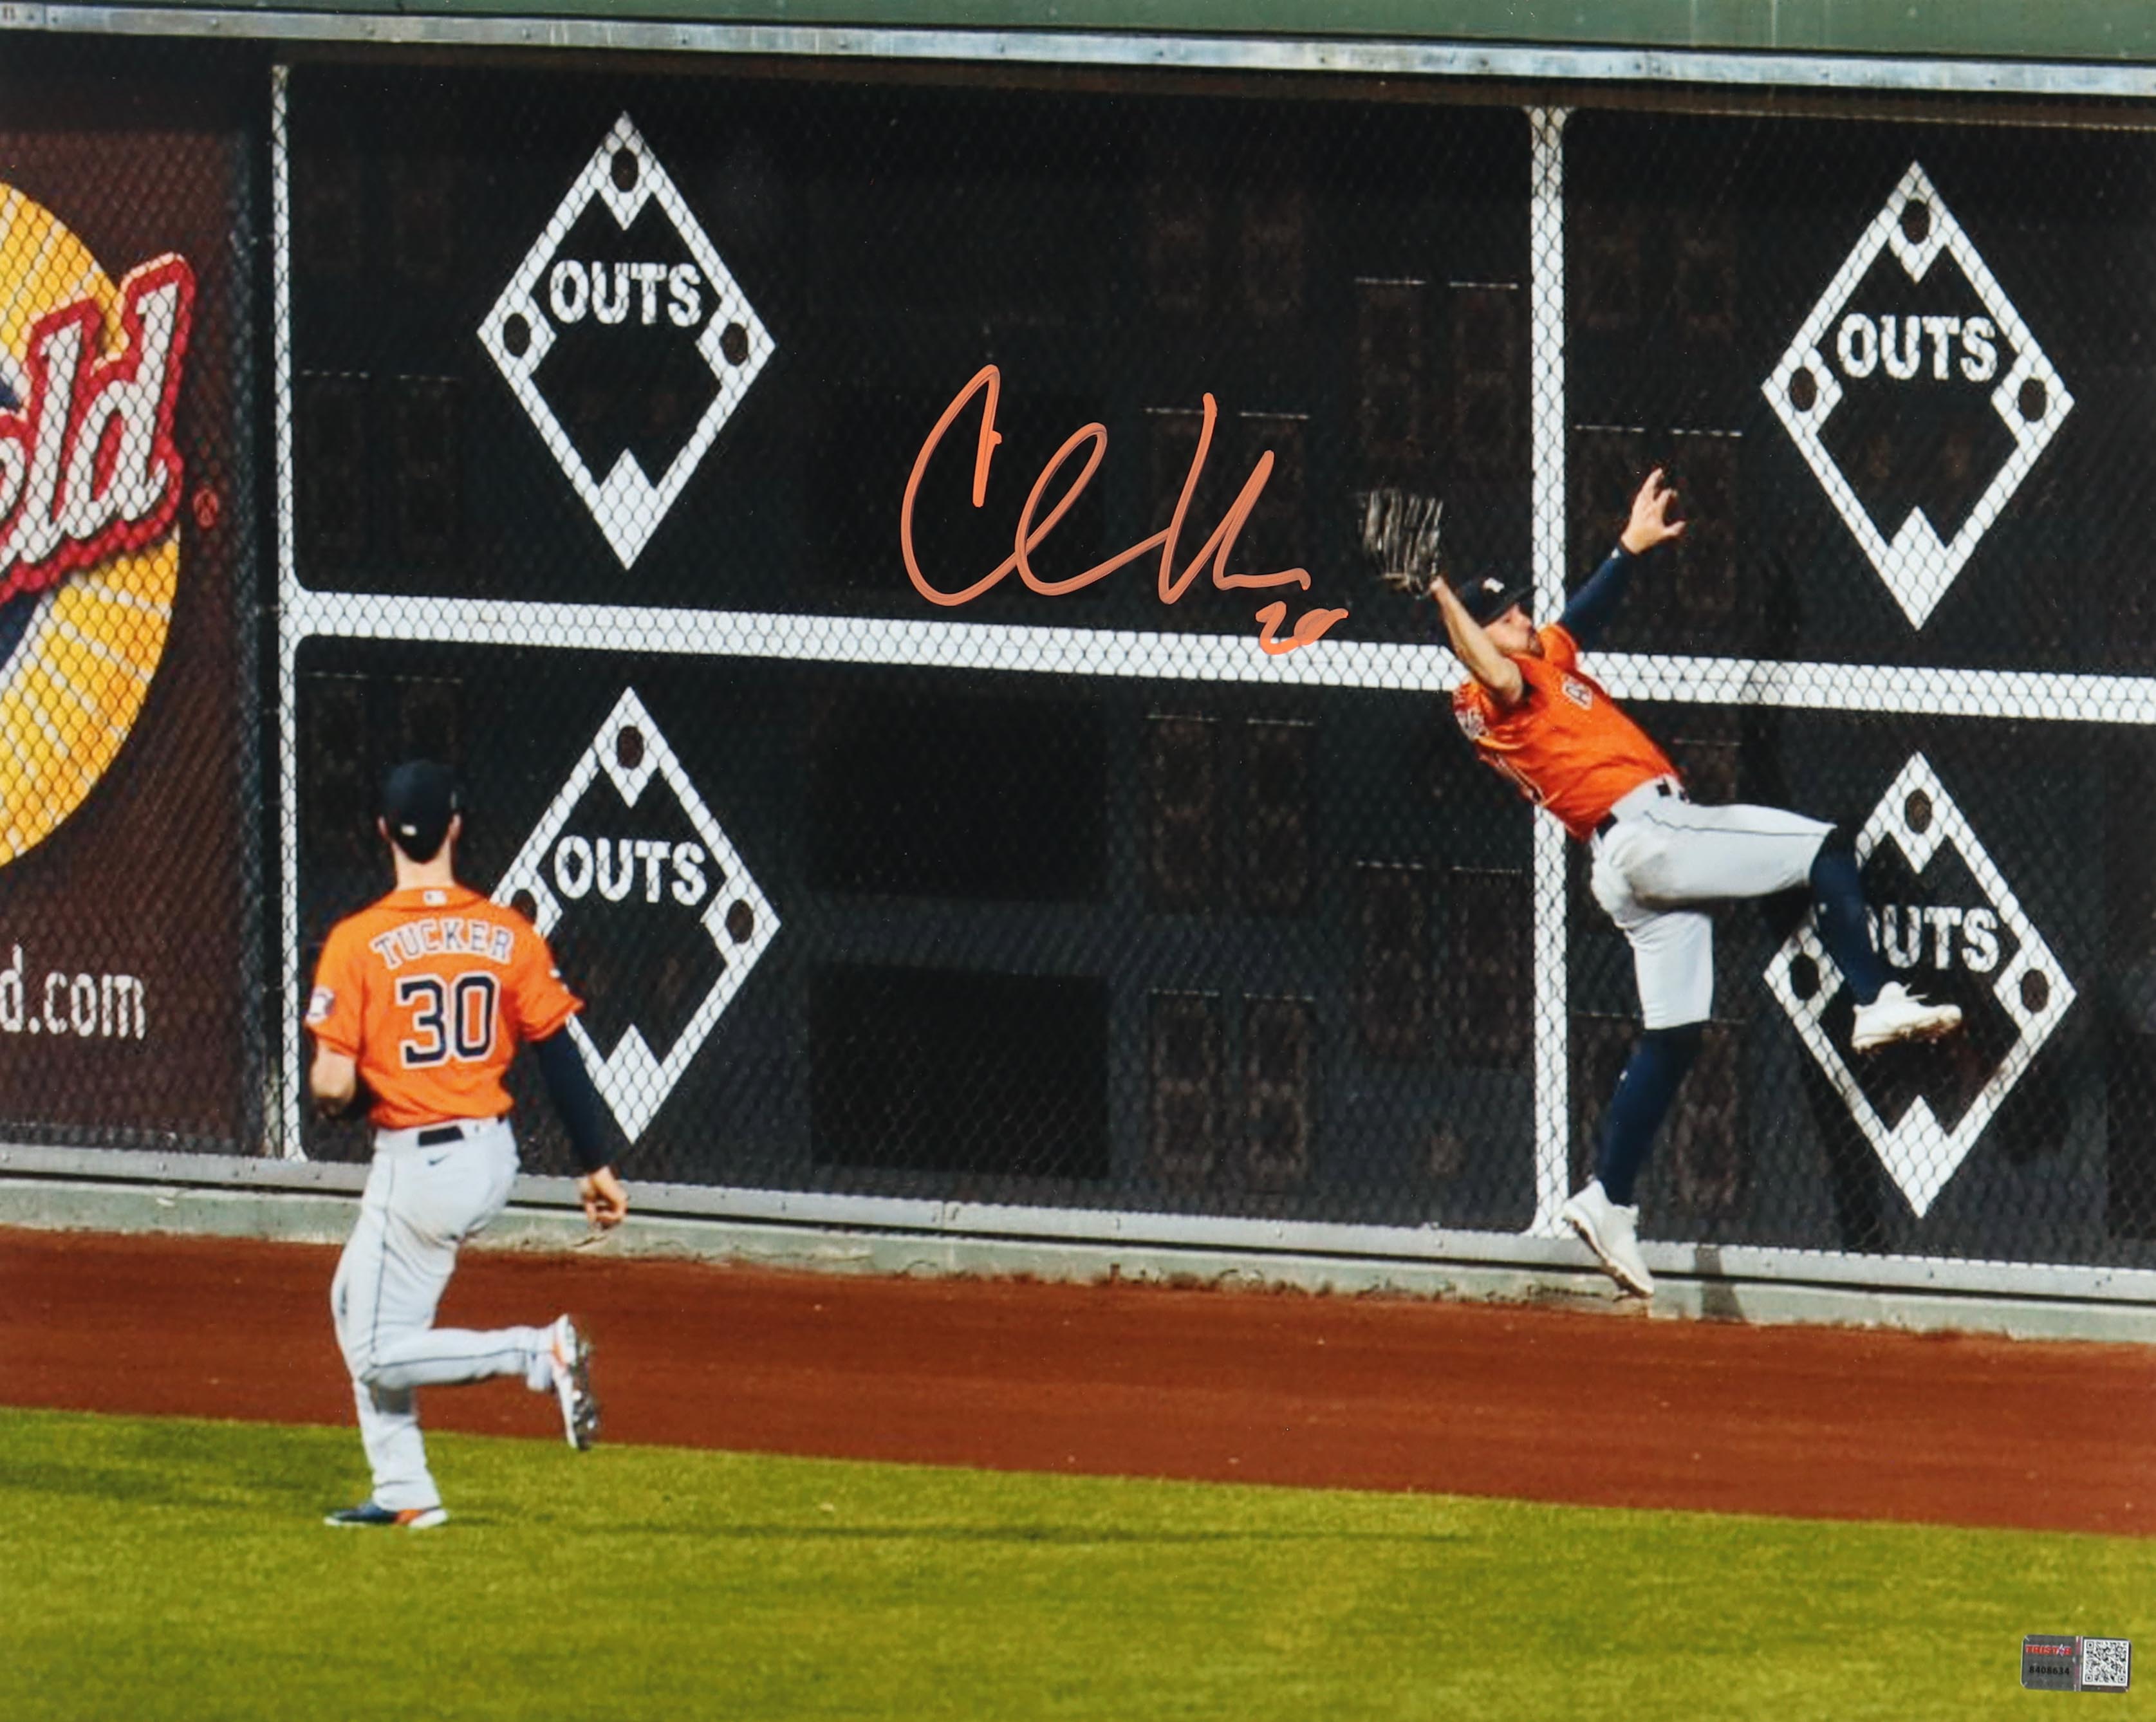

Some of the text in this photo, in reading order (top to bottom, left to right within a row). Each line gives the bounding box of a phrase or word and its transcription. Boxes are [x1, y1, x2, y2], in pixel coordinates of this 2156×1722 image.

[550, 259, 702, 327] OUTS
[1837, 313, 1997, 382] OUTS
[554, 835, 707, 906] OUTS
[369, 918, 515, 970] TUCKER
[1866, 904, 1999, 973] UTS
[395, 972, 500, 1069] 30
